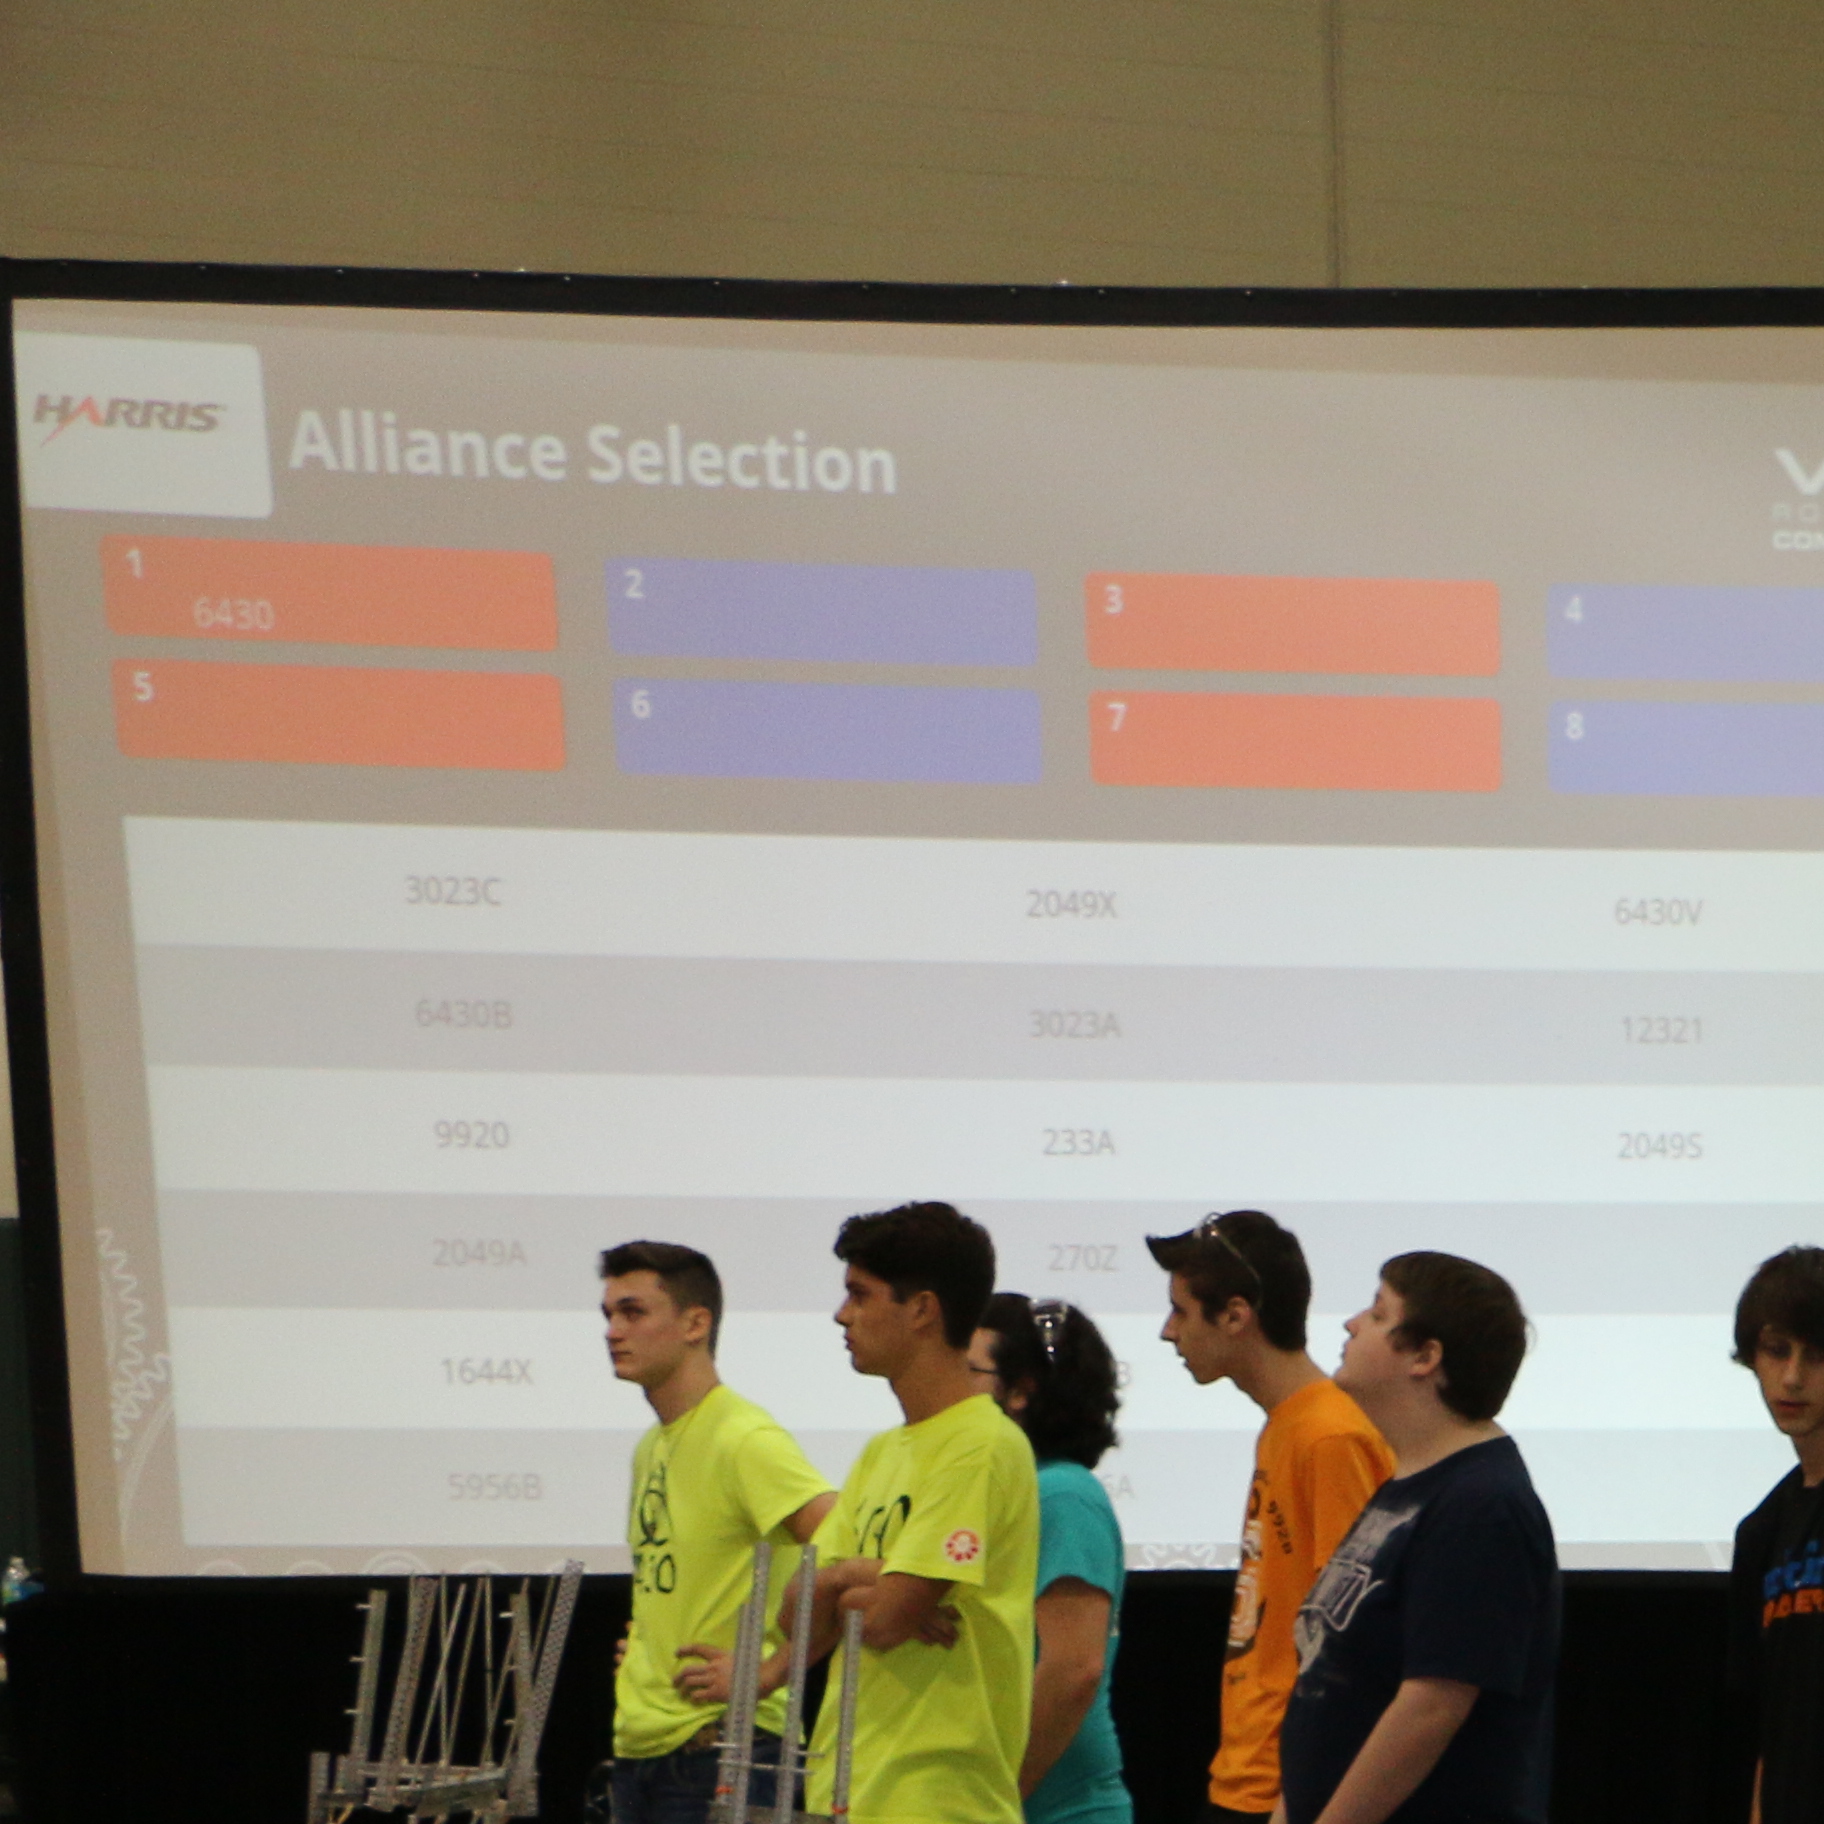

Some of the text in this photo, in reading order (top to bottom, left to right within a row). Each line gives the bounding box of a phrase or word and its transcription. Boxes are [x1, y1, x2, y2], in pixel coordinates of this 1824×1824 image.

[33, 395, 222, 445] HARRIS
[290, 411, 897, 495] Alliance Selection
[126, 548, 143, 577] 1
[625, 570, 644, 598] 2
[194, 596, 275, 631] 6430
[1104, 585, 1123, 616] 3
[1564, 595, 1582, 623] 4
[134, 671, 153, 701] 5
[631, 690, 651, 719] 6
[1107, 704, 1126, 732] 7
[1565, 712, 1584, 741] 8
[405, 875, 502, 908] 3023C
[1025, 887, 1117, 920] 2049X
[1614, 896, 1703, 929] 6430V
[416, 998, 512, 1031] 6430B
[1030, 1009, 1121, 1041] 3023A
[1621, 1015, 1704, 1046] 12321
[434, 1119, 511, 1151] 9920
[1042, 1127, 1117, 1157] 233A
[1617, 1131, 1704, 1163] 2049S
[432, 1238, 526, 1268] 2049A
[1048, 1242, 1117, 1273] 270Z
[442, 1356, 533, 1387] 1644X
[448, 1472, 542, 1502] 5956B
